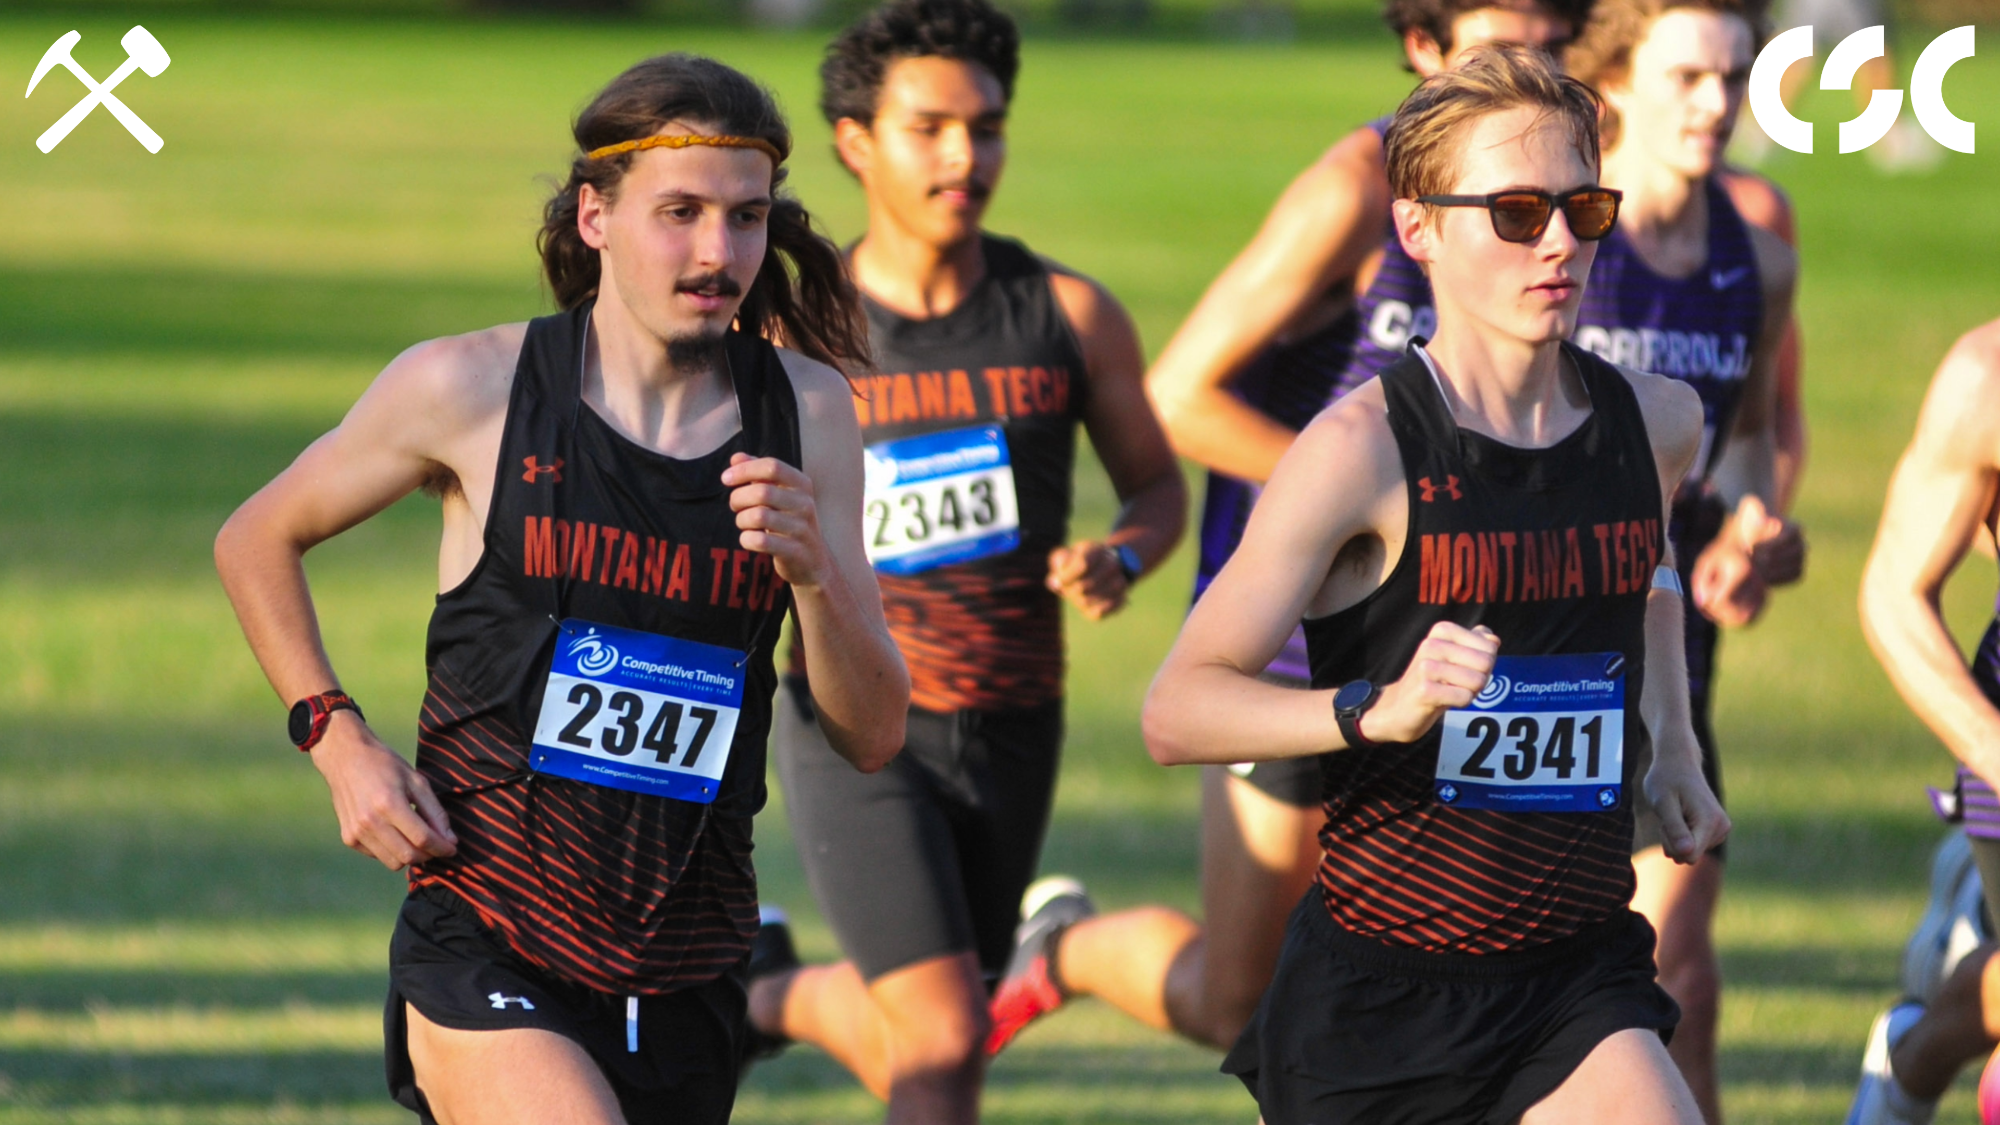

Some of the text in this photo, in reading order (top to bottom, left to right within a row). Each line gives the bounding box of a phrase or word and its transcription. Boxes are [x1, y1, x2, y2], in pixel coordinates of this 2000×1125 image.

[850, 366, 1071, 427] NTANA TECH
[865, 476, 999, 548] 2343
[524, 515, 691, 603] MONTANA
[1418, 526, 1586, 606] MONTANA
[557, 682, 719, 769] 2347
[1459, 715, 1604, 781] 2341
